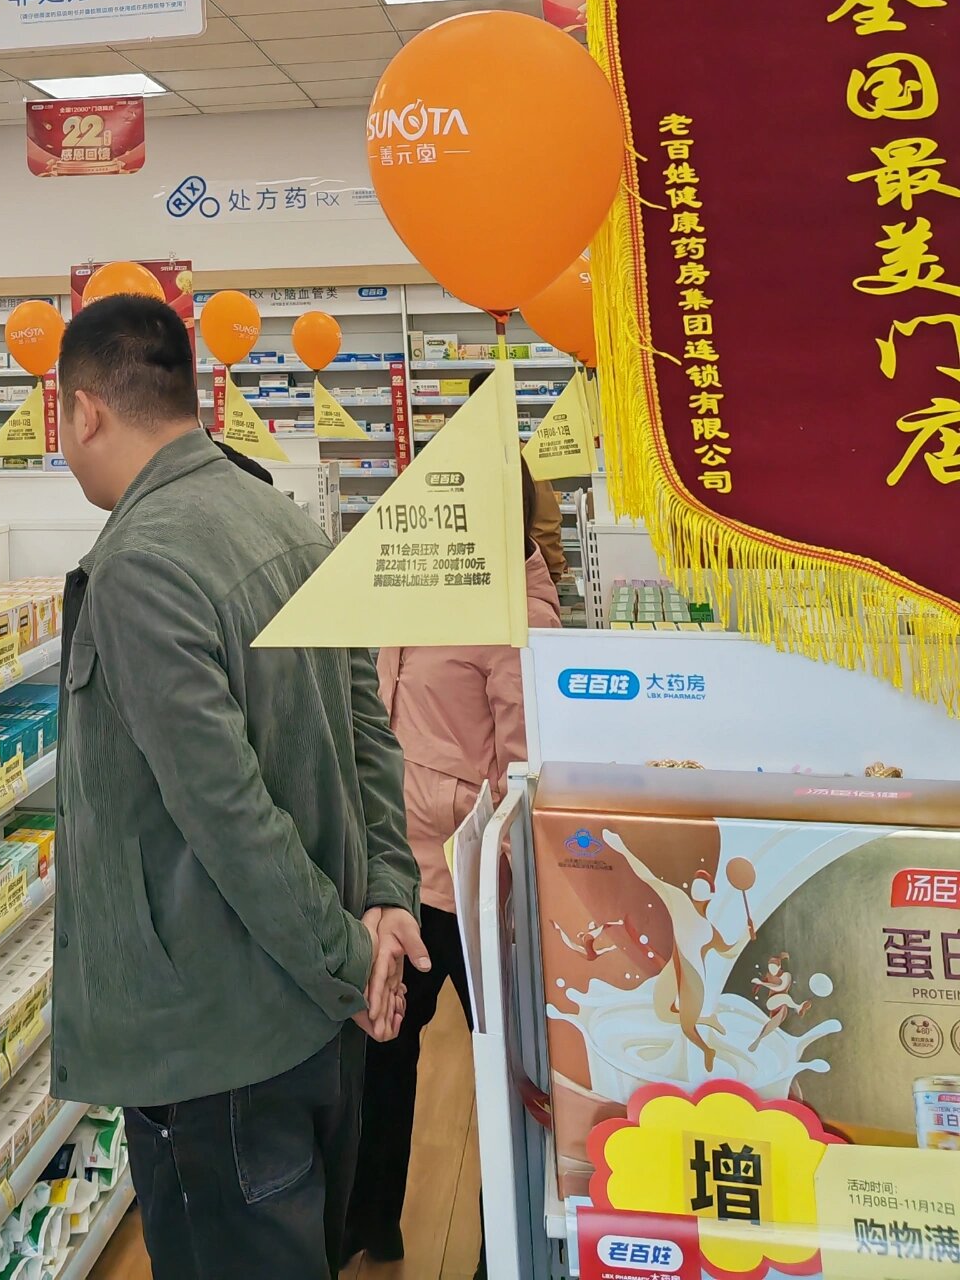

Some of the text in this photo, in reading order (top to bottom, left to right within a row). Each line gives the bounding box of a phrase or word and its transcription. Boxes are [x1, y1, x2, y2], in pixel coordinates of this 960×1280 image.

[61, 114, 105, 147] 22
[60, 147, 112, 161] 感恩回馈
[228, 186, 308, 212] 处方药
[316, 191, 341, 207] Rx
[248, 286, 339, 301] Rx 心脑血管类
[658, 112, 733, 495] 老百姓健康药房集团连锁有限公司
[376, 503, 469, 534] 11月08-12日
[380, 542, 476, 556] 双11会员狂欢 内购节
[375, 557, 487, 572] 满22减11元 200减100元
[373, 572, 492, 588] 满额送礼加送券 空盒当钱花
[568, 673, 630, 696] 老百姓
[645, 672, 706, 691] 大药房
[646, 692, 707, 701] LBX PHARMACY
[906, 874, 960, 904] 汤臣
[690, 1138, 763, 1226] 增
[848, 1194, 956, 1217] 11月08日-11月12日
[608, 1241, 671, 1266] 老百姓
